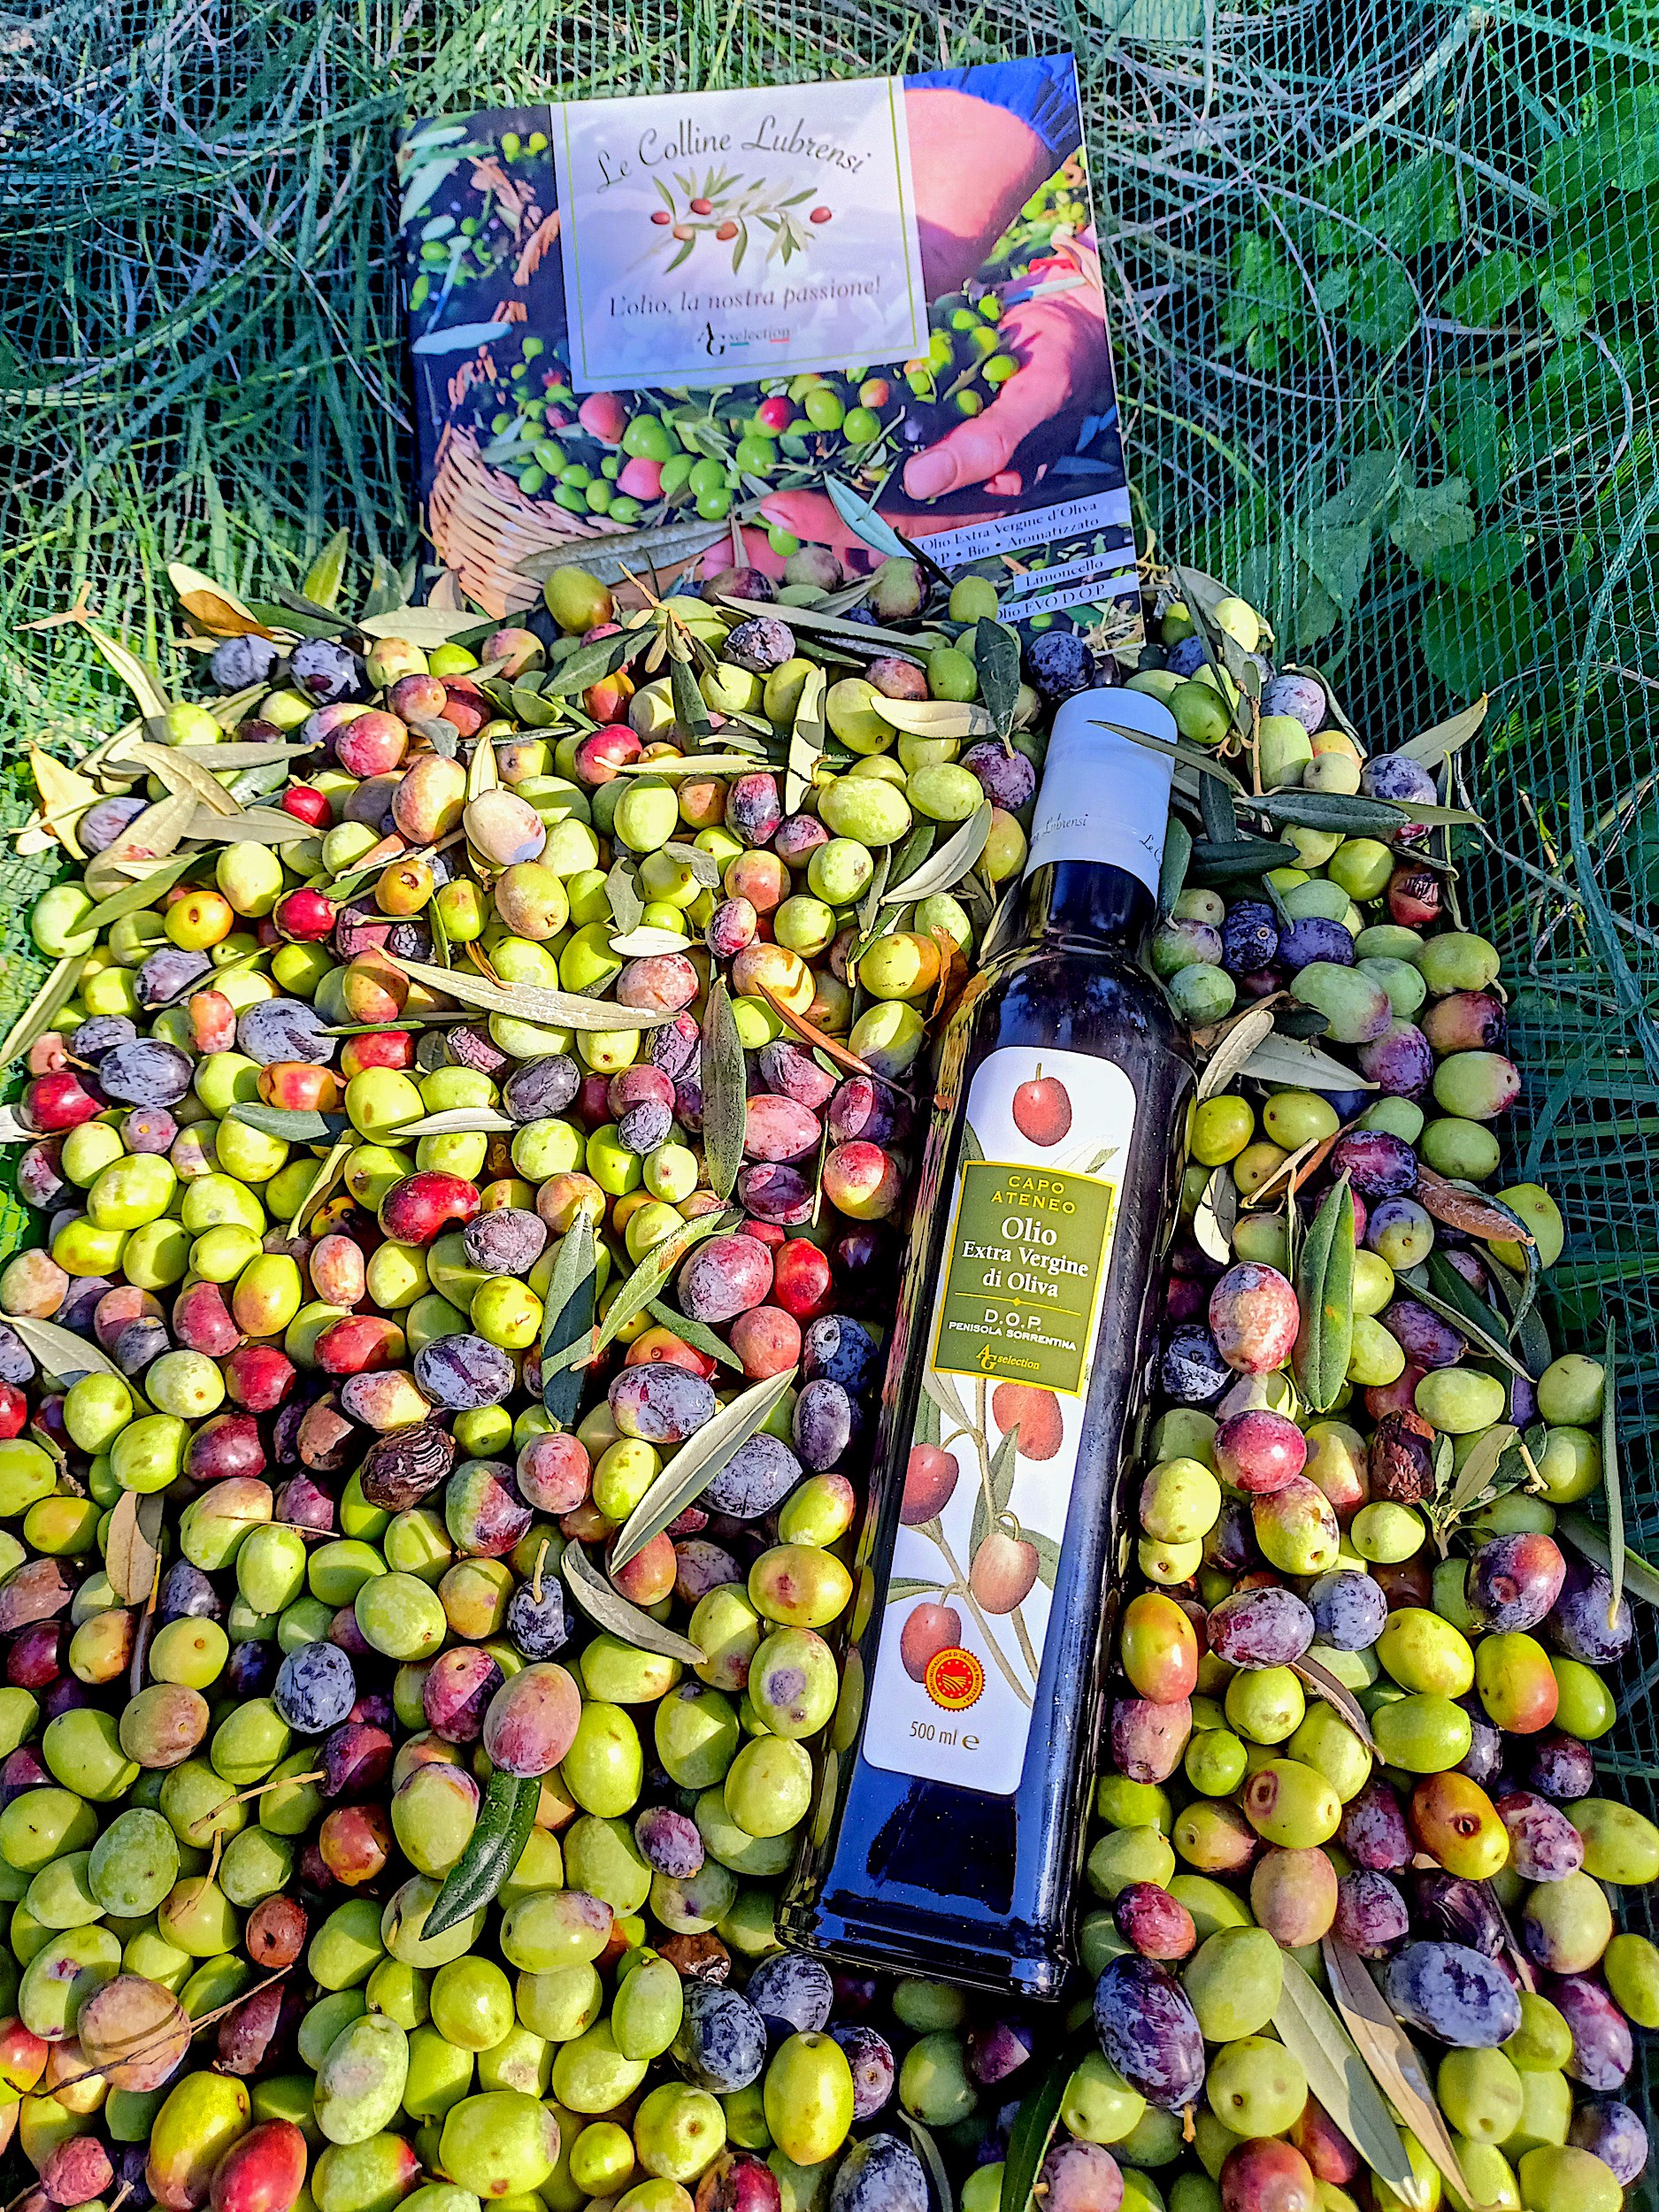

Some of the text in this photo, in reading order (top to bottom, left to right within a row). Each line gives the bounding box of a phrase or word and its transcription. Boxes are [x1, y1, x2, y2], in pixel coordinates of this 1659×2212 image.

[596, 114, 872, 194] Le Colline Lubrensi
[610, 275, 881, 318] L'olio, la nostra passione!
[921, 503, 1097, 551] Olio Extra Vergine d'Oliva
[968, 545, 990, 558] Bio
[1008, 517, 1100, 548] Aromatizzato
[1025, 560, 1103, 587] Limoncello
[1025, 595, 1058, 613] EVO
[1064, 584, 1106, 604] D.O.P.
[1042, 813, 1089, 836] Lubrensi
[1008, 1175, 1065, 1194] CAPO
[991, 1190, 1077, 1214] ATENEO
[1001, 1216, 1057, 1247] Olio
[962, 1240, 1089, 1278] Extra Vergine
[982, 1268, 1059, 1298] di Oliva
[984, 1308, 1042, 1332] D.O.P.
[949, 1321, 1077, 1351] PENISOLA SORRENTINA
[997, 1355, 1041, 1371] selection
[929, 1652, 952, 1694] DENOMINAZIONE
[909, 1720, 935, 1741] 500
[939, 1729, 958, 1746] ml
